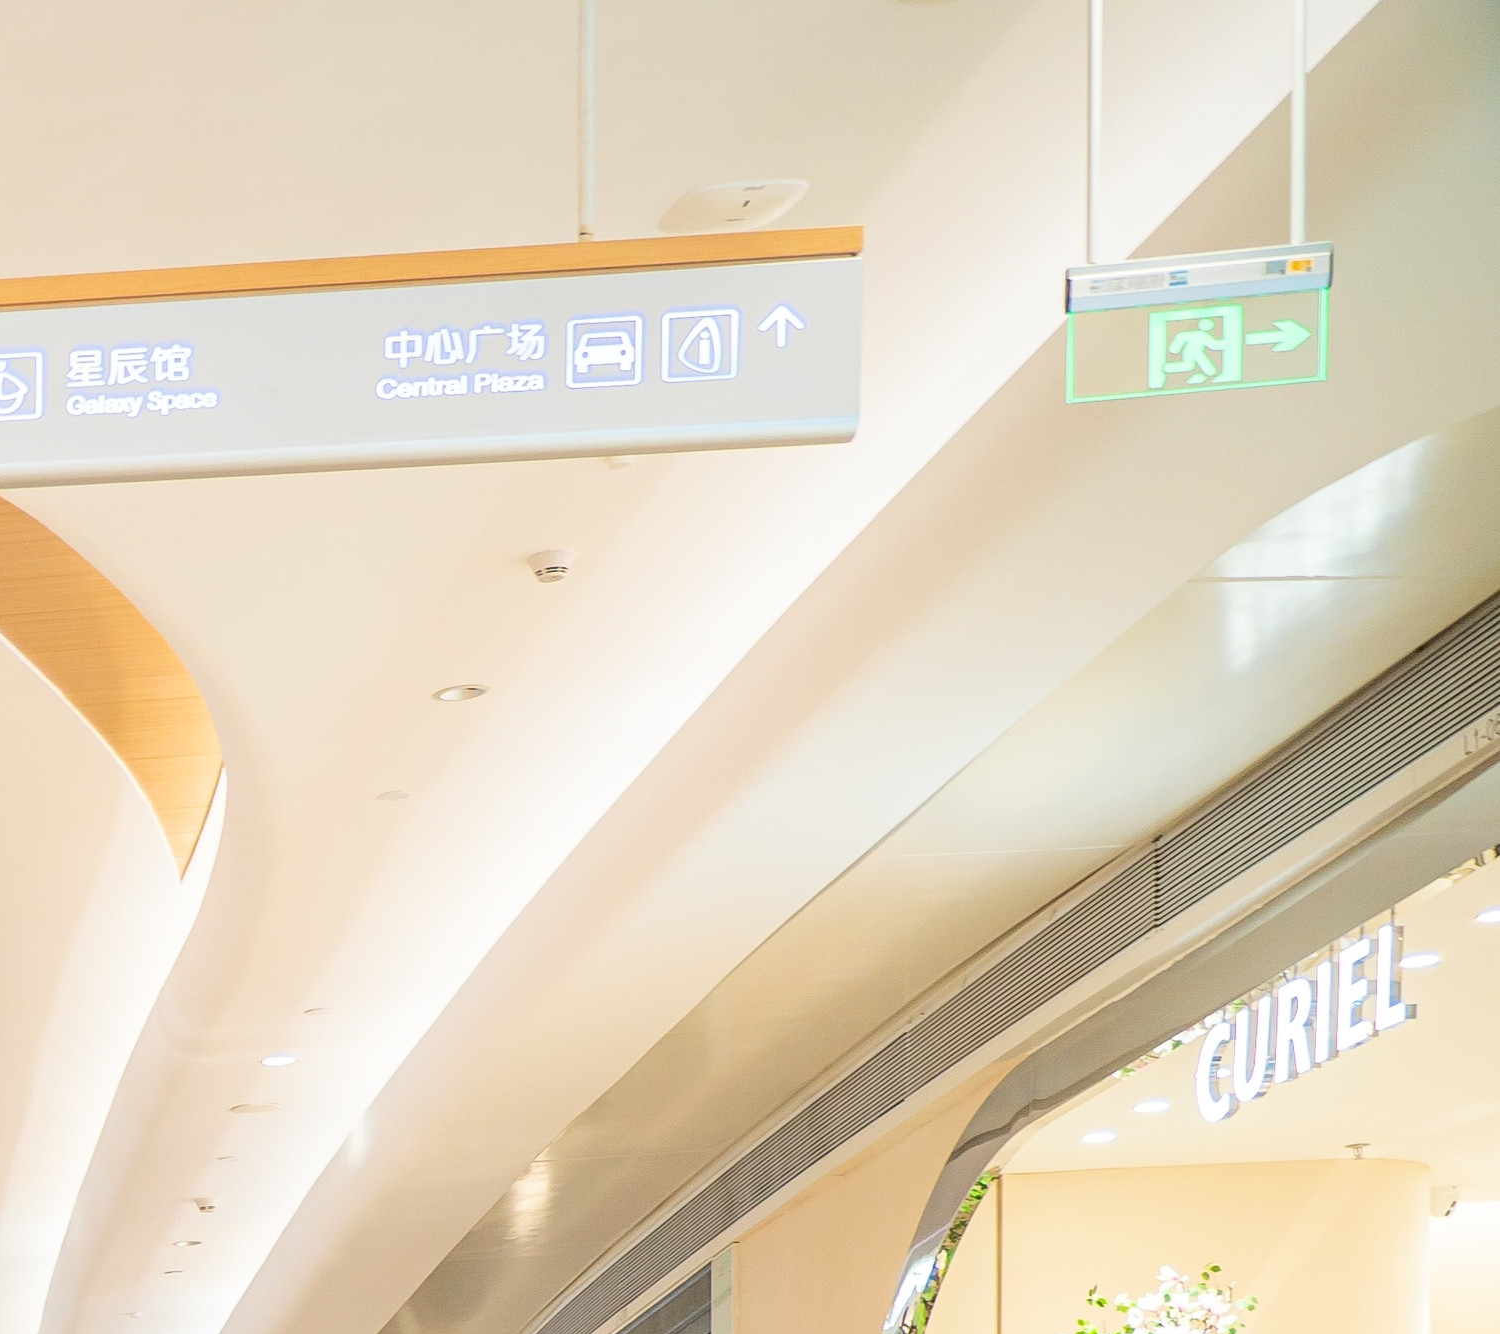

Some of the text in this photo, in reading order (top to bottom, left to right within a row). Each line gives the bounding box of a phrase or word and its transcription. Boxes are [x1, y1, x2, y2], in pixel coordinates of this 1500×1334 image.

[65, 344, 192, 388] 星辰馆
[384, 323, 546, 369] 中心广场
[66, 390, 218, 417] Galaxy Space
[375, 373, 544, 399] Central Plaza
[1196, 923, 1407, 1122] CURIEL
